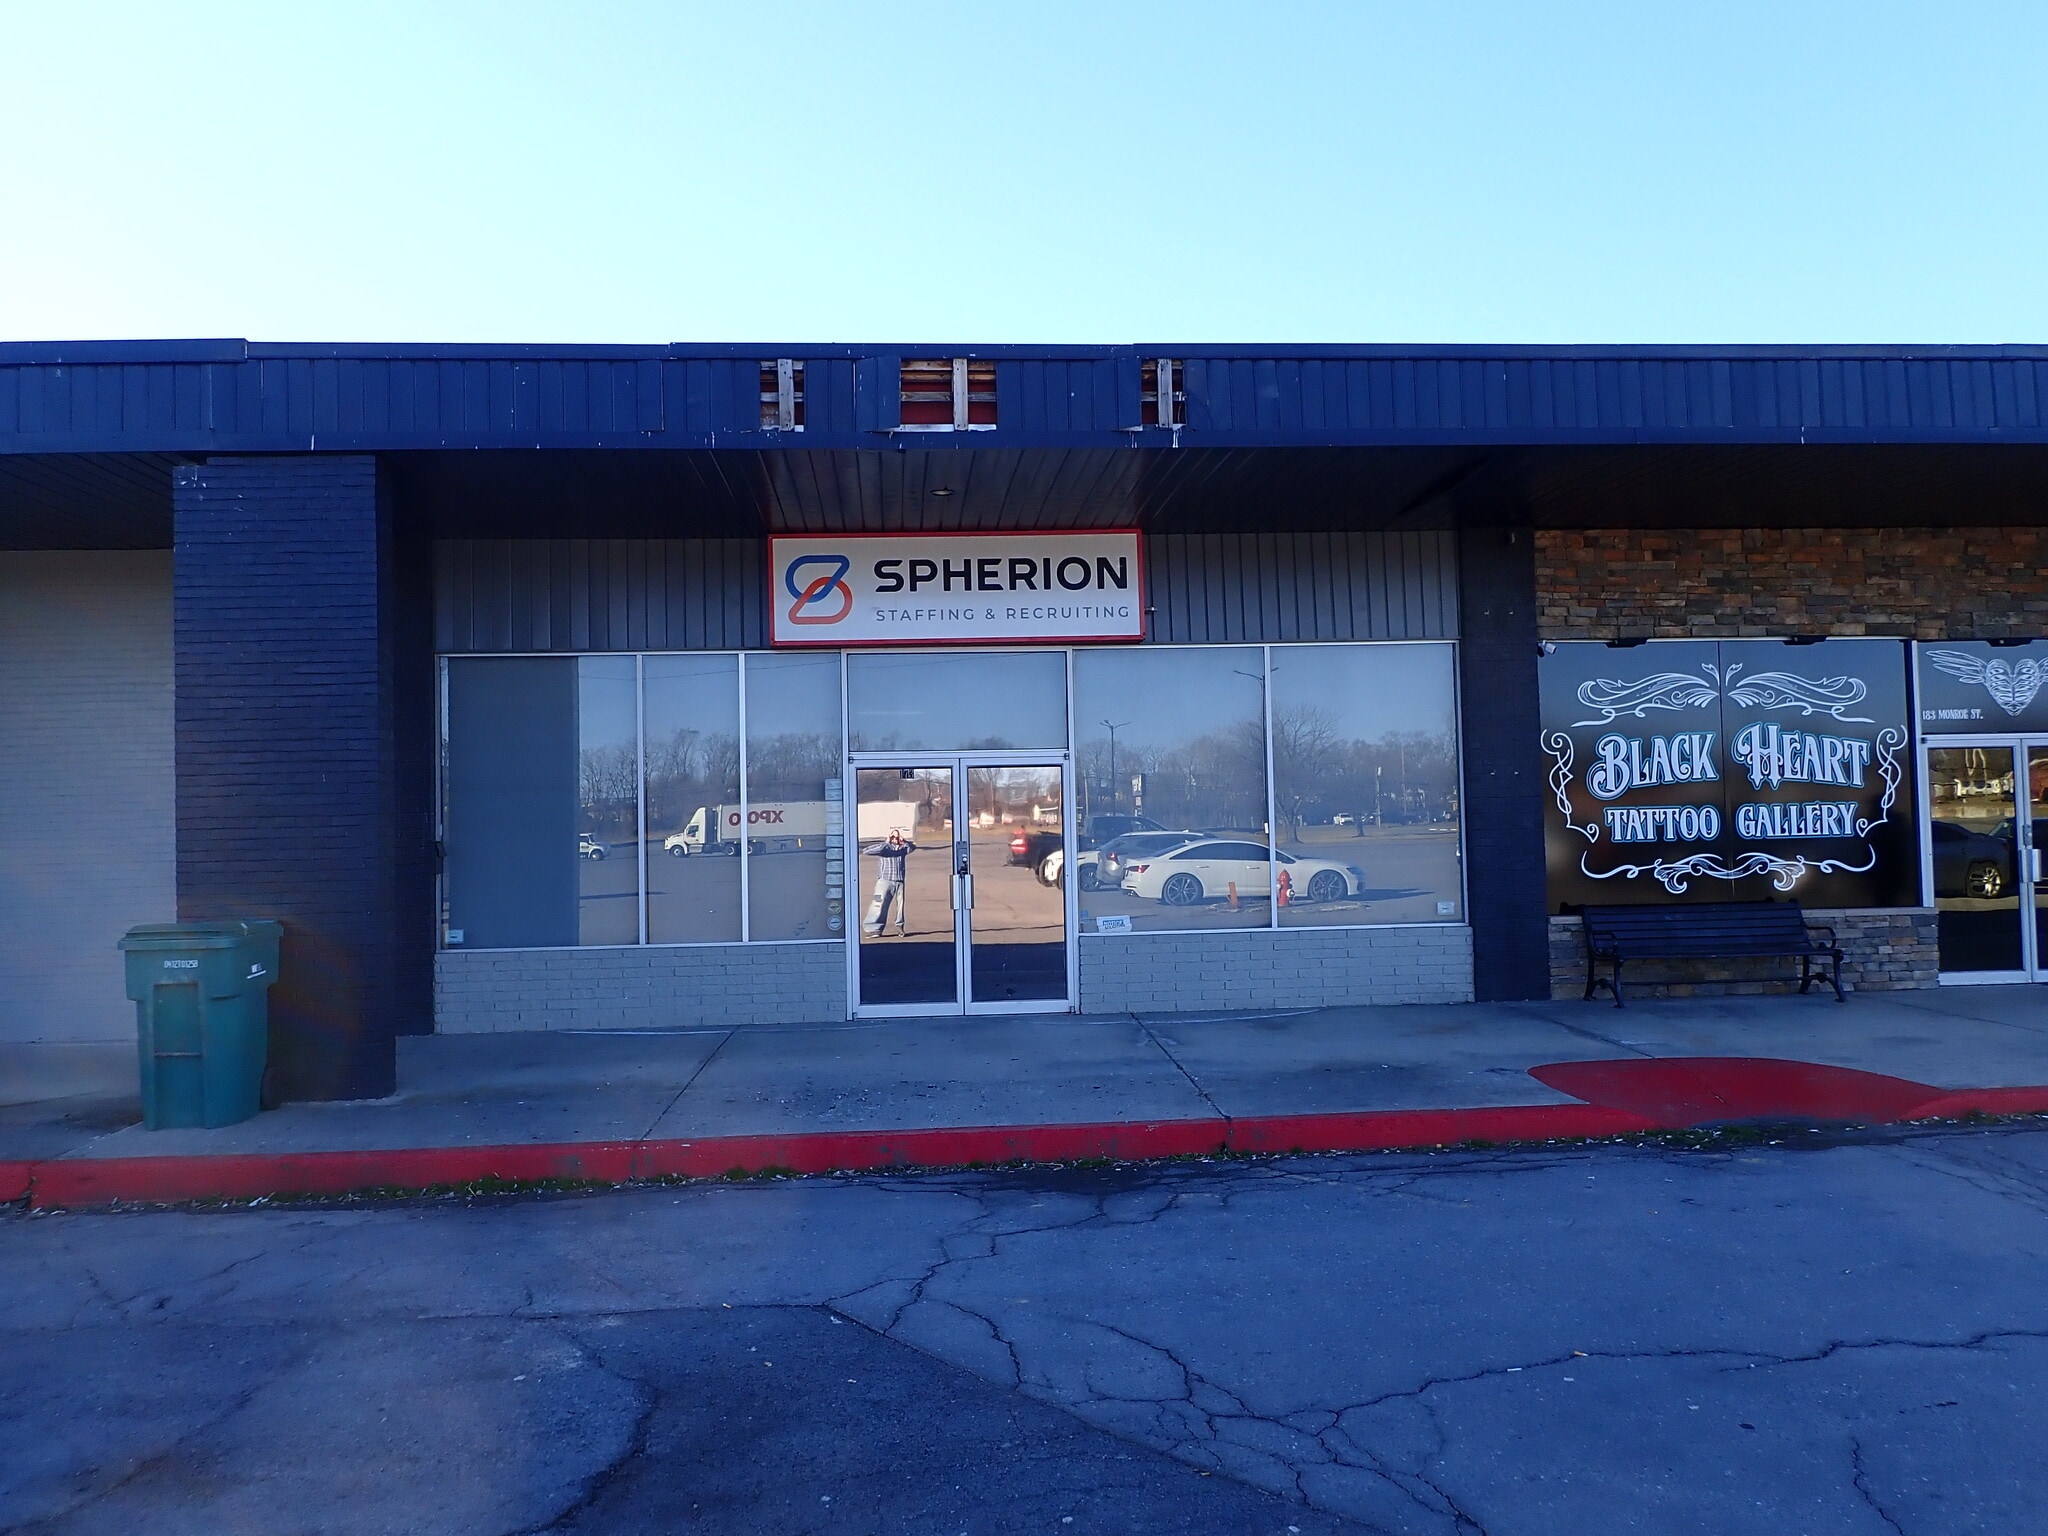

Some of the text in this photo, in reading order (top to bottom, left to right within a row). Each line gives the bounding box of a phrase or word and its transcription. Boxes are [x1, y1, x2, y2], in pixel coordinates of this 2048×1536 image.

[873, 556, 1128, 593] SPHERION
[876, 606, 1130, 622] STAFFING & RECRUITING
[1938, 709, 1969, 720] MONROE
[1970, 708, 1984, 720] ST.
[1587, 722, 1871, 801] BLACK HEART
[1604, 802, 1860, 843] TATTOO GALLERY
